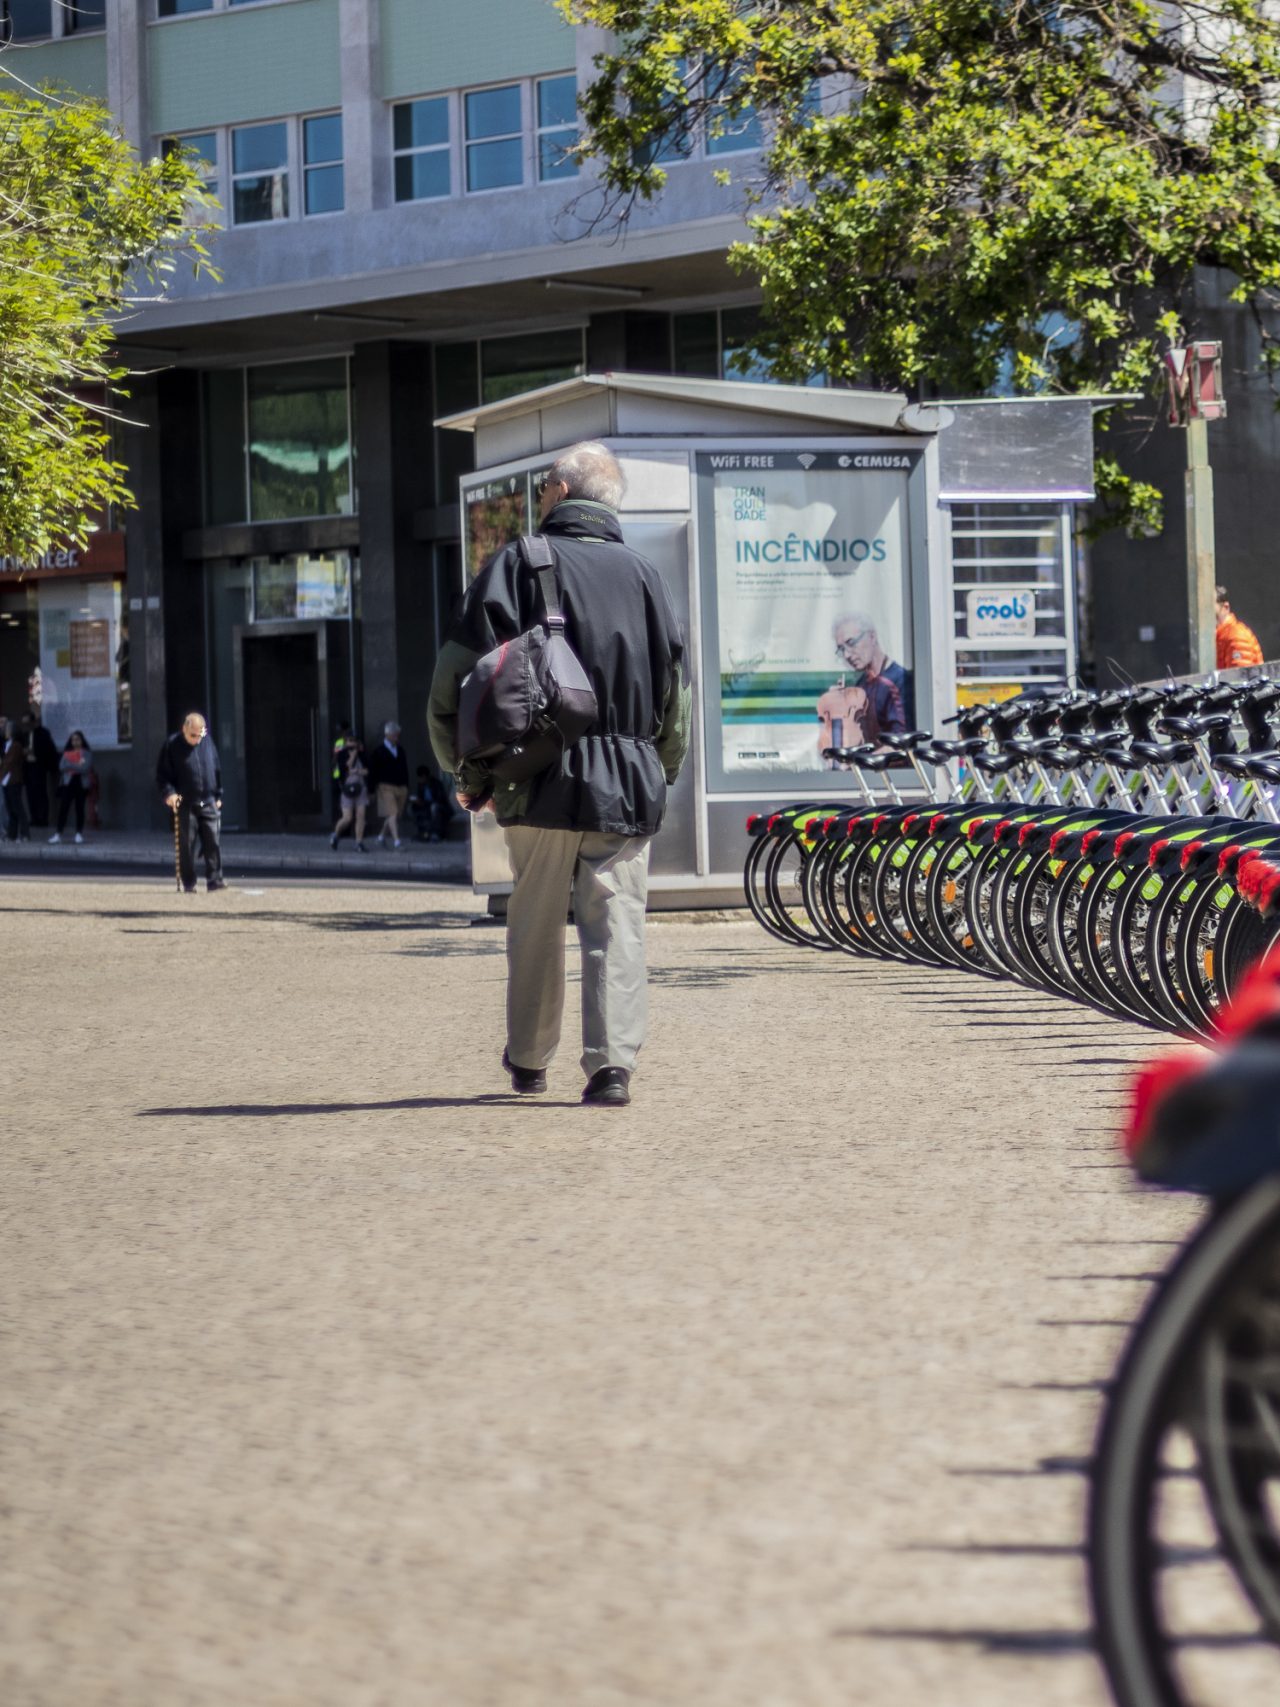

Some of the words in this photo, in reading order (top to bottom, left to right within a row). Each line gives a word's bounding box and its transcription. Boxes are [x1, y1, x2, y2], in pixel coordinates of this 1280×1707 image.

[710, 455, 740, 468] WiFi
[744, 455, 774, 468] FREE
[854, 455, 911, 468] CEMUSA
[734, 486, 765, 497] TRAN
[734, 510, 766, 521] DADE
[735, 532, 887, 563] INCÊNDIOS
[977, 597, 1026, 620] mob
